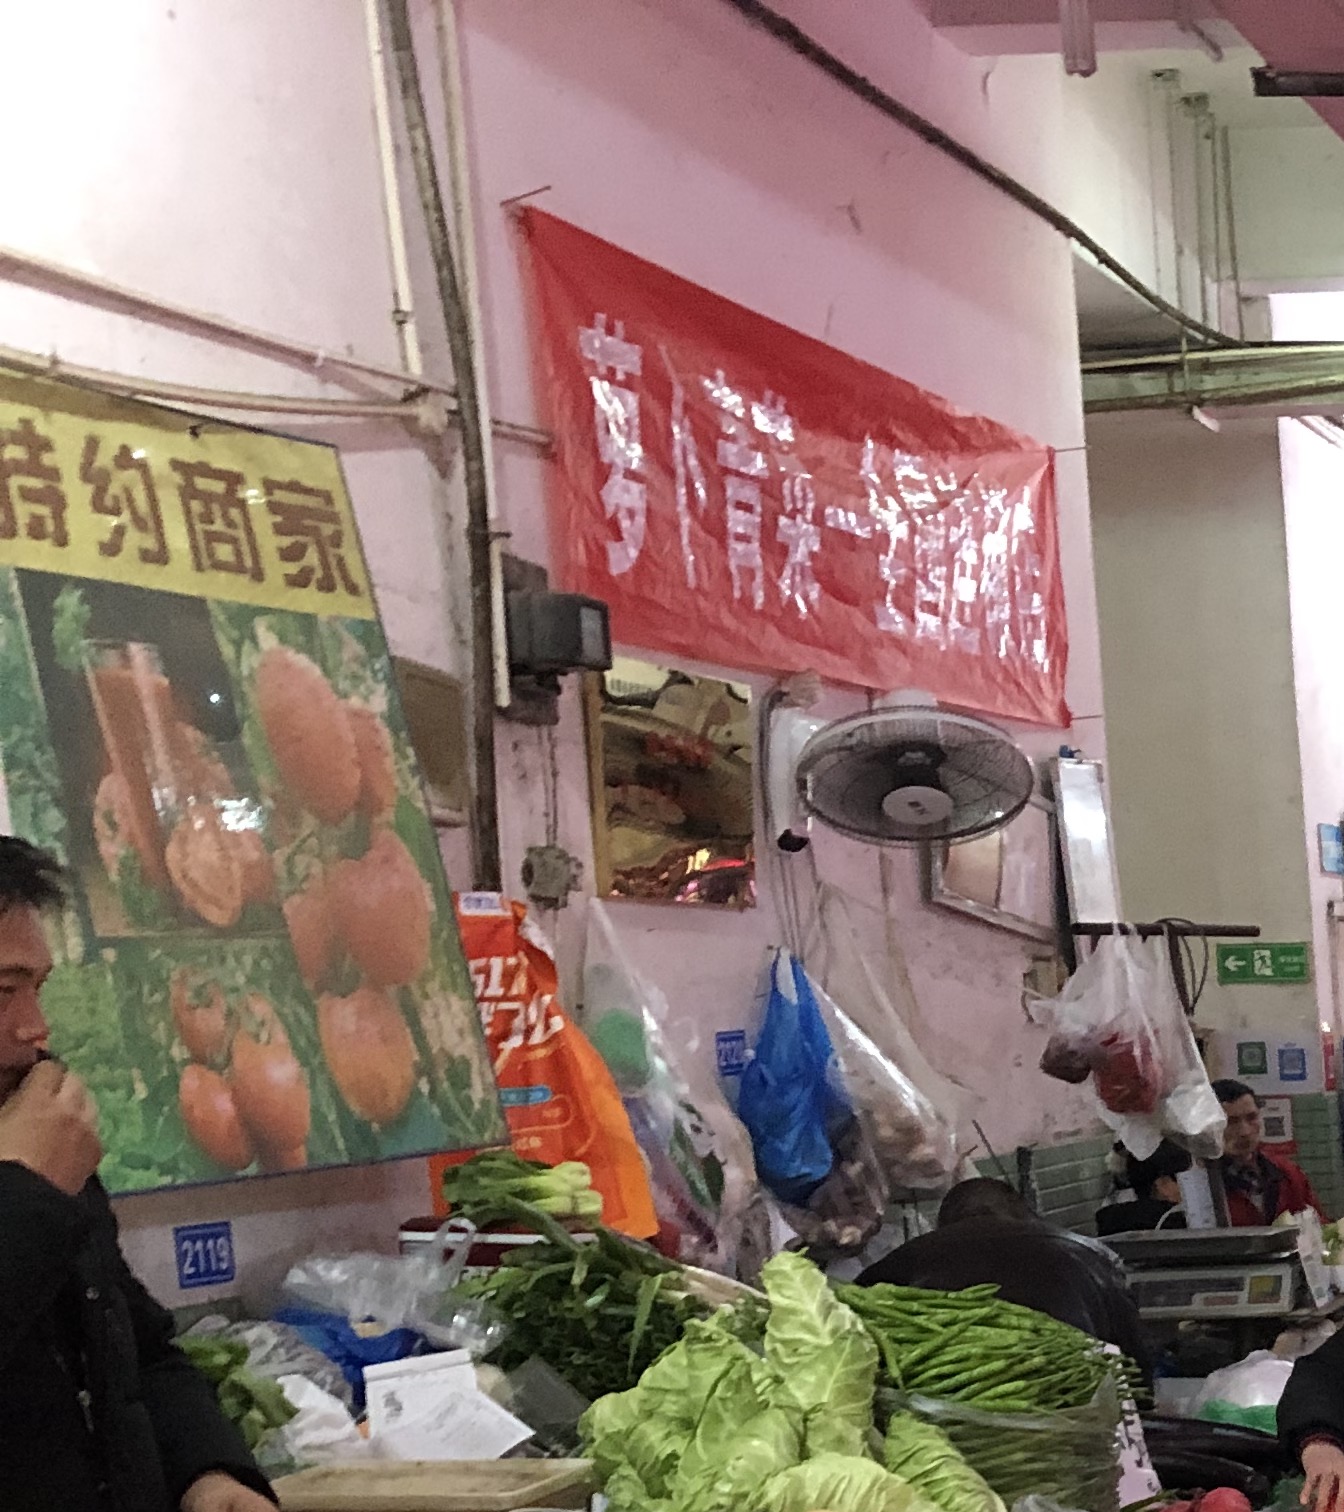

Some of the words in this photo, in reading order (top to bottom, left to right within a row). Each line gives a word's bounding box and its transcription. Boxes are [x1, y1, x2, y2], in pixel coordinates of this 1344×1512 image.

[0, 416, 362, 596] 特约商家
[182, 1237, 230, 1274] 2119
